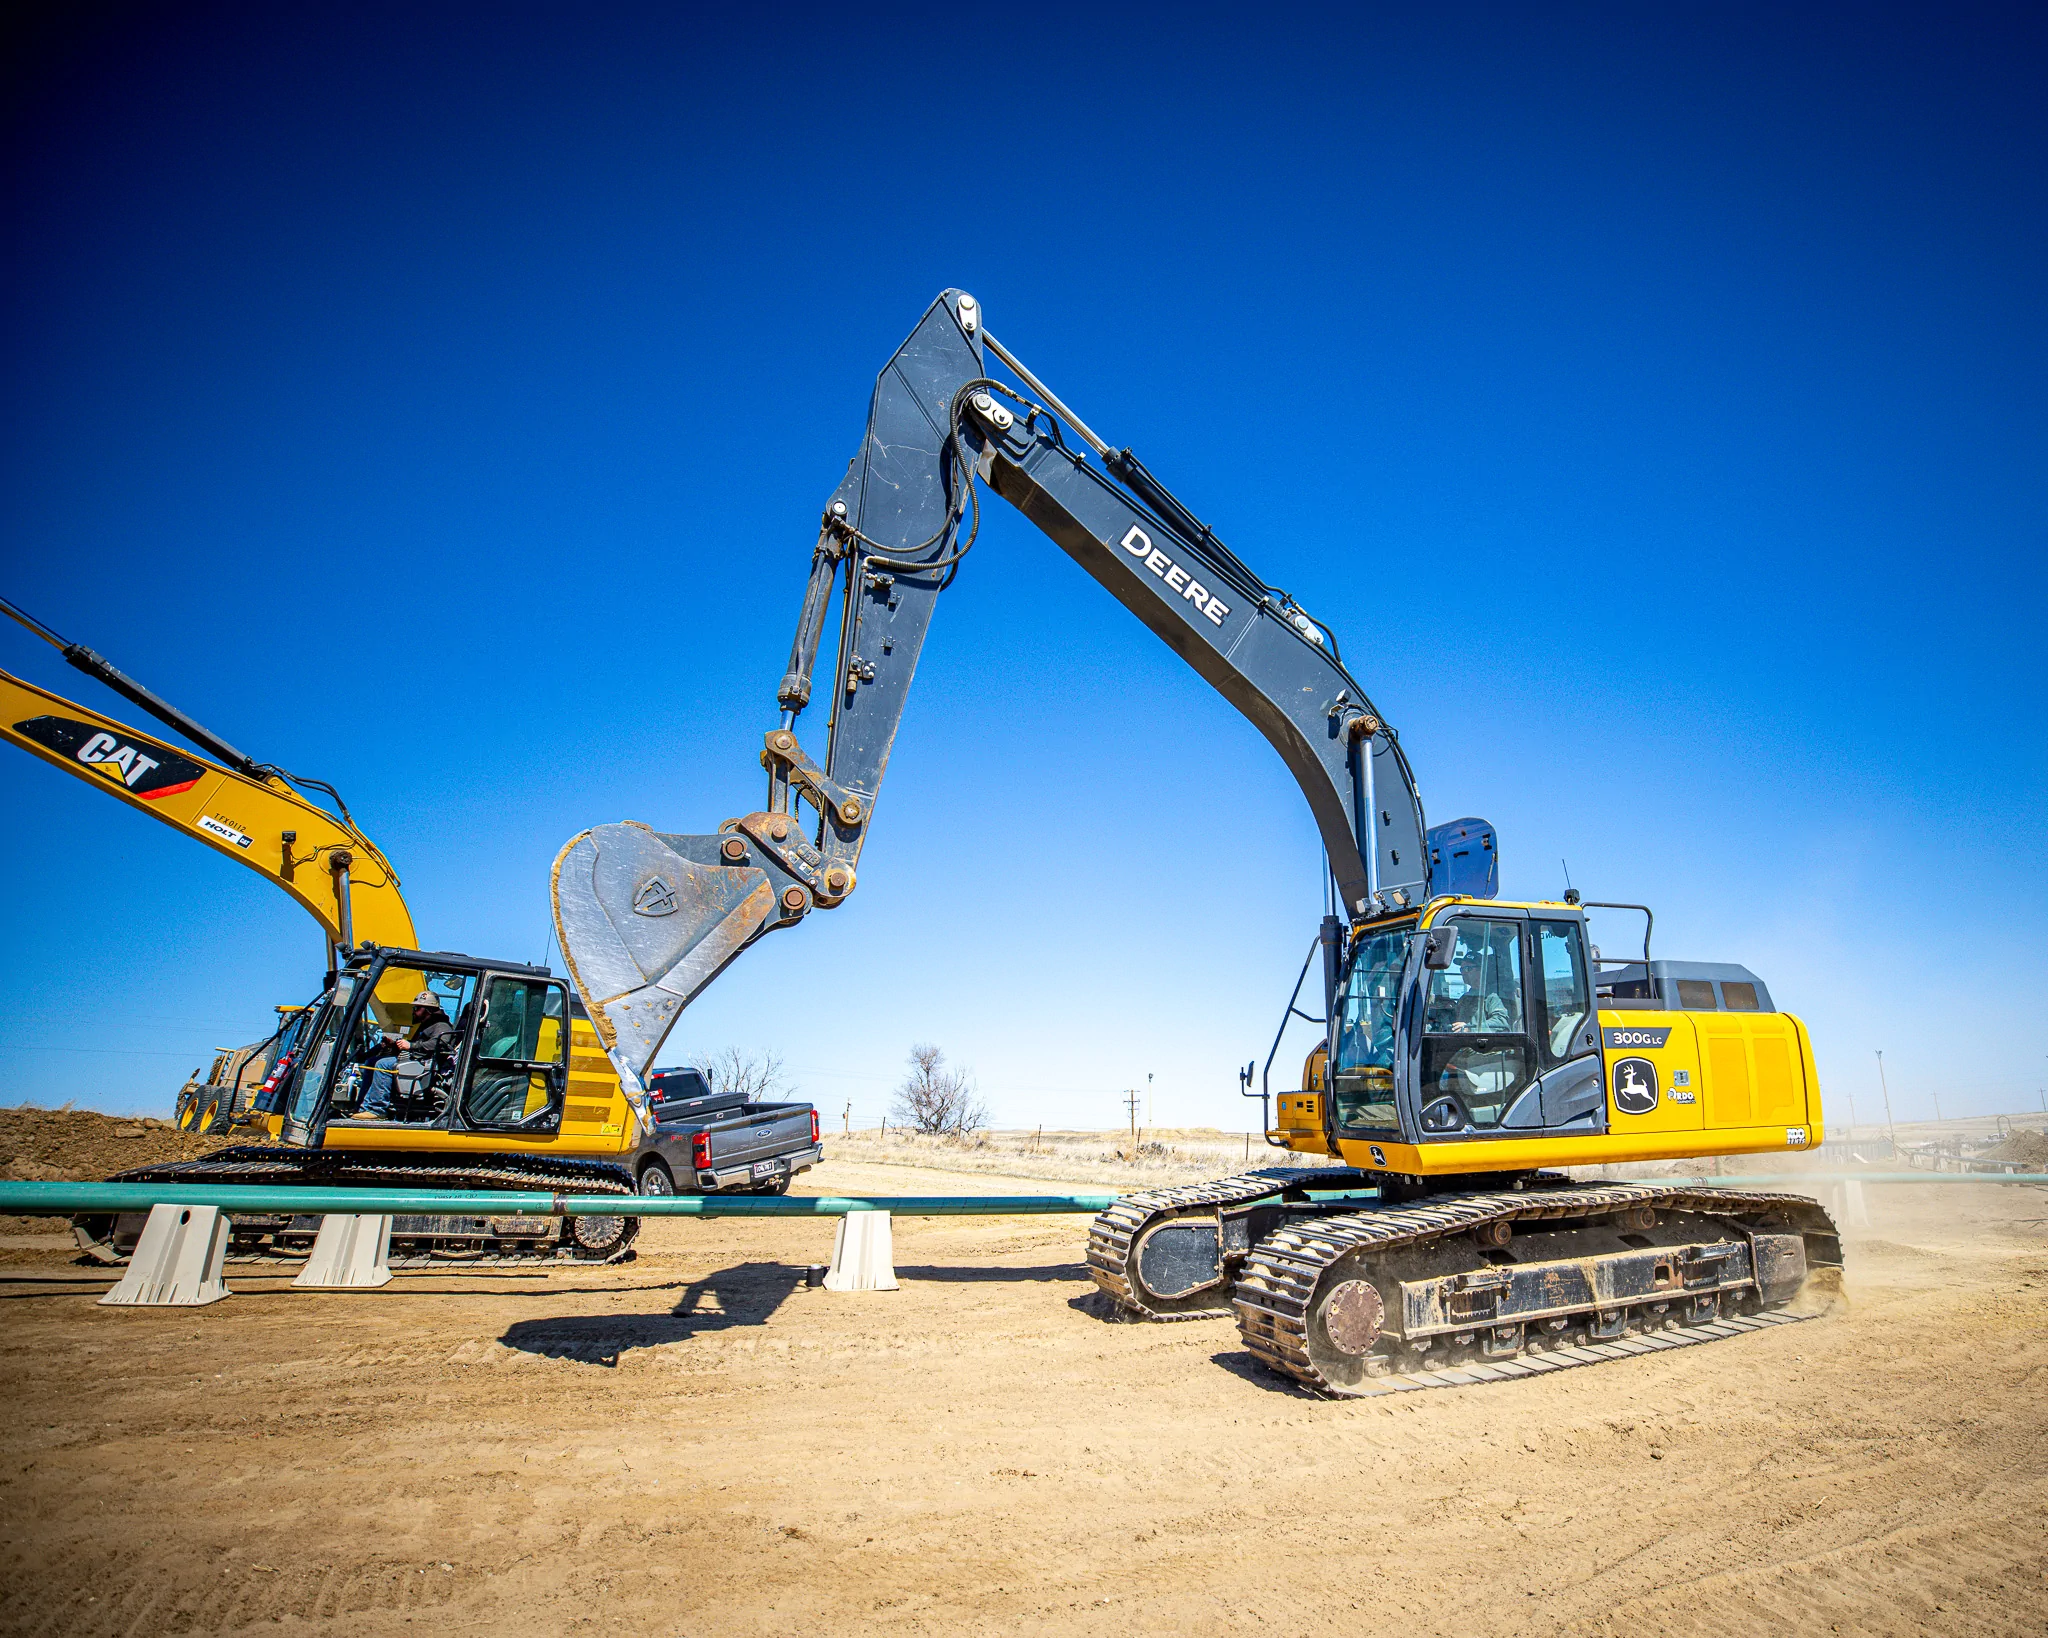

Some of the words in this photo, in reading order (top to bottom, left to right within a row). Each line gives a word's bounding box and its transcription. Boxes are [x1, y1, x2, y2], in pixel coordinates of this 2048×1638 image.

[1120, 524, 1230, 626] DEERE
[77, 732, 160, 787] CAT
[204, 821, 237, 838] HOLT
[214, 812, 247, 832] TFX0112
[1613, 1032, 1651, 1044] 300G
